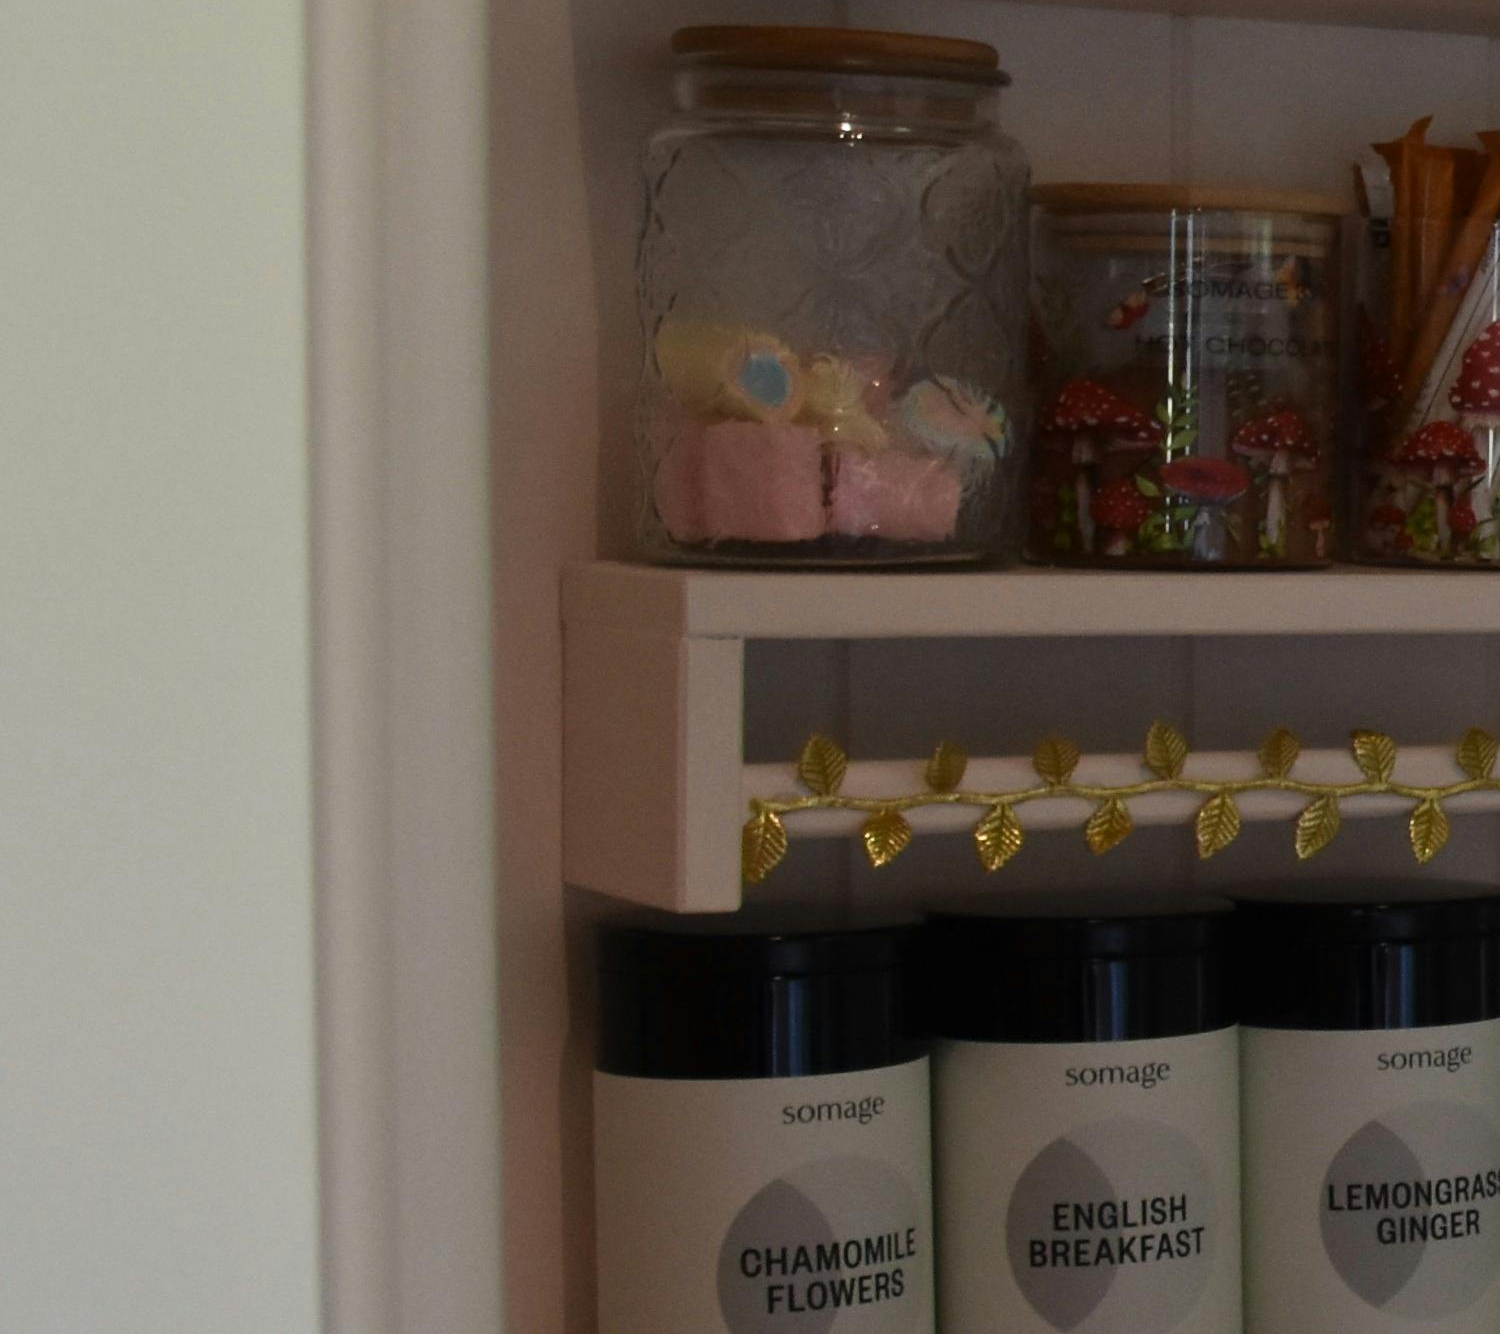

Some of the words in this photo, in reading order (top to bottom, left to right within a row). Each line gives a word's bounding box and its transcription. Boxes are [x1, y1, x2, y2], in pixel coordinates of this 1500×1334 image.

[1065, 1062, 1171, 1089] somage
[1376, 1046, 1472, 1073] somage
[782, 1095, 886, 1125] somage
[1052, 1193, 1187, 1233] ENGLISH
[1376, 1208, 1481, 1245] GINGER
[740, 1227, 917, 1278] CHAMOMILE
[1029, 1226, 1206, 1268] BREAKFAST
[767, 1267, 906, 1315] FLOWERS
